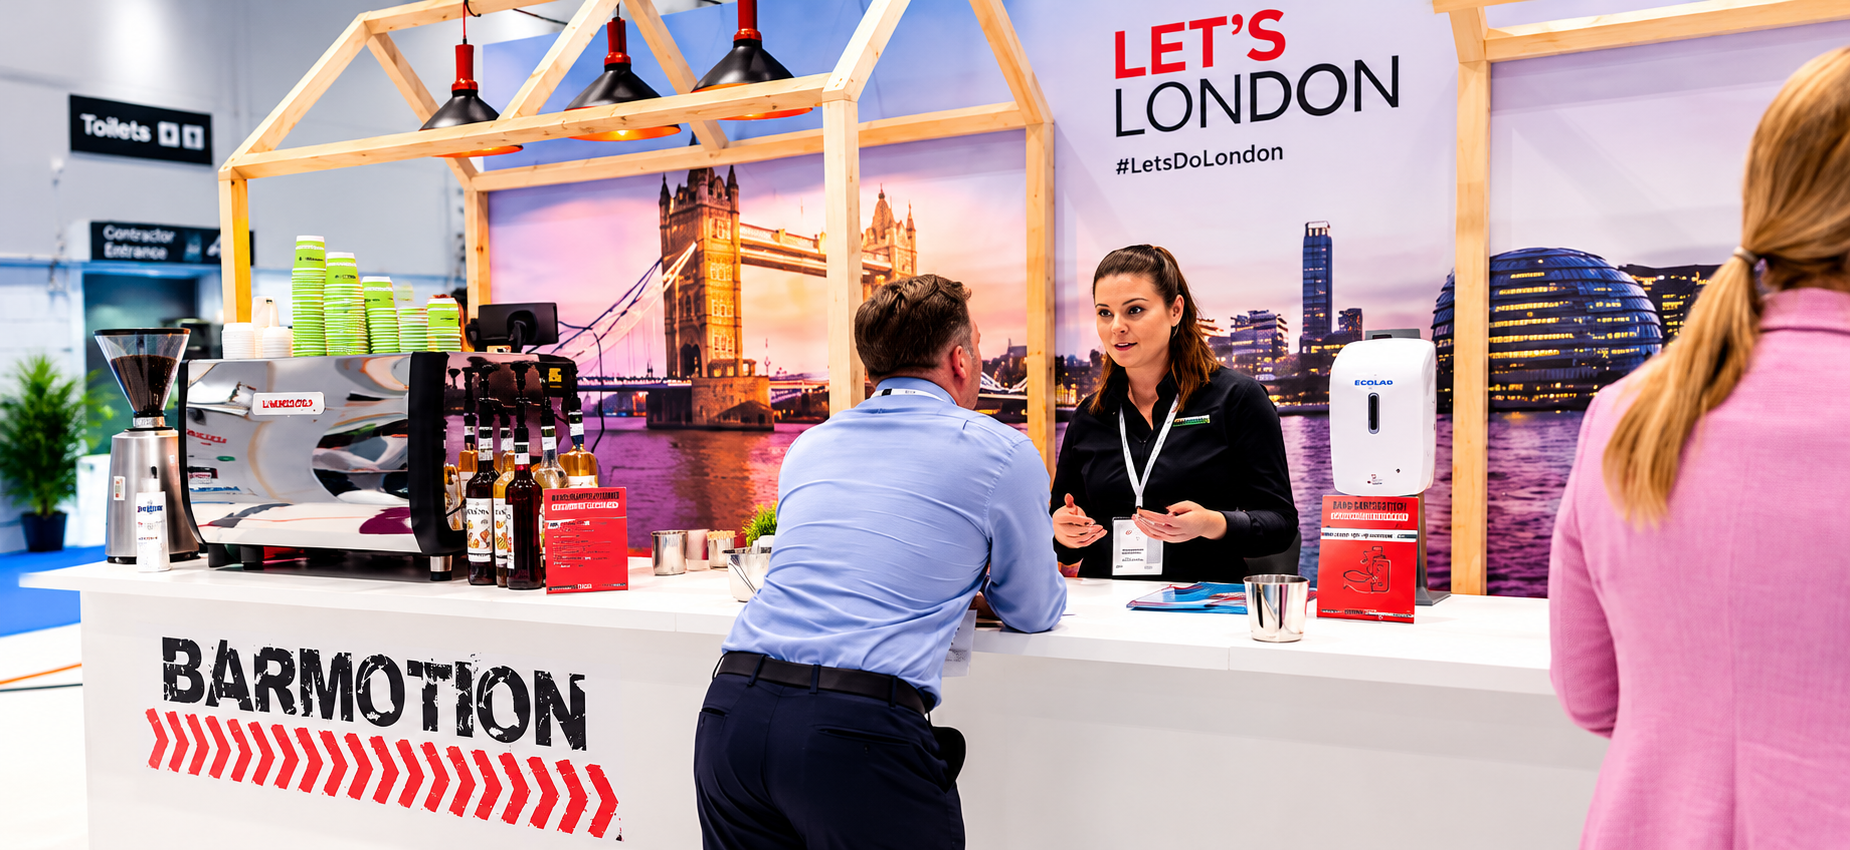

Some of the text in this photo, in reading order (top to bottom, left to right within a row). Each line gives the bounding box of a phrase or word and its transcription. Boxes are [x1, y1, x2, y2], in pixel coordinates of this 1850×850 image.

[1115, 9, 1286, 79] LET'S
[1115, 55, 1399, 137] LONDON
[80, 113, 152, 142] Toilets
[1116, 144, 1283, 175] #LetsDoLondon
[103, 225, 175, 244] Contractor
[104, 242, 168, 260] Entrance
[162, 637, 588, 751] BARMOTION
